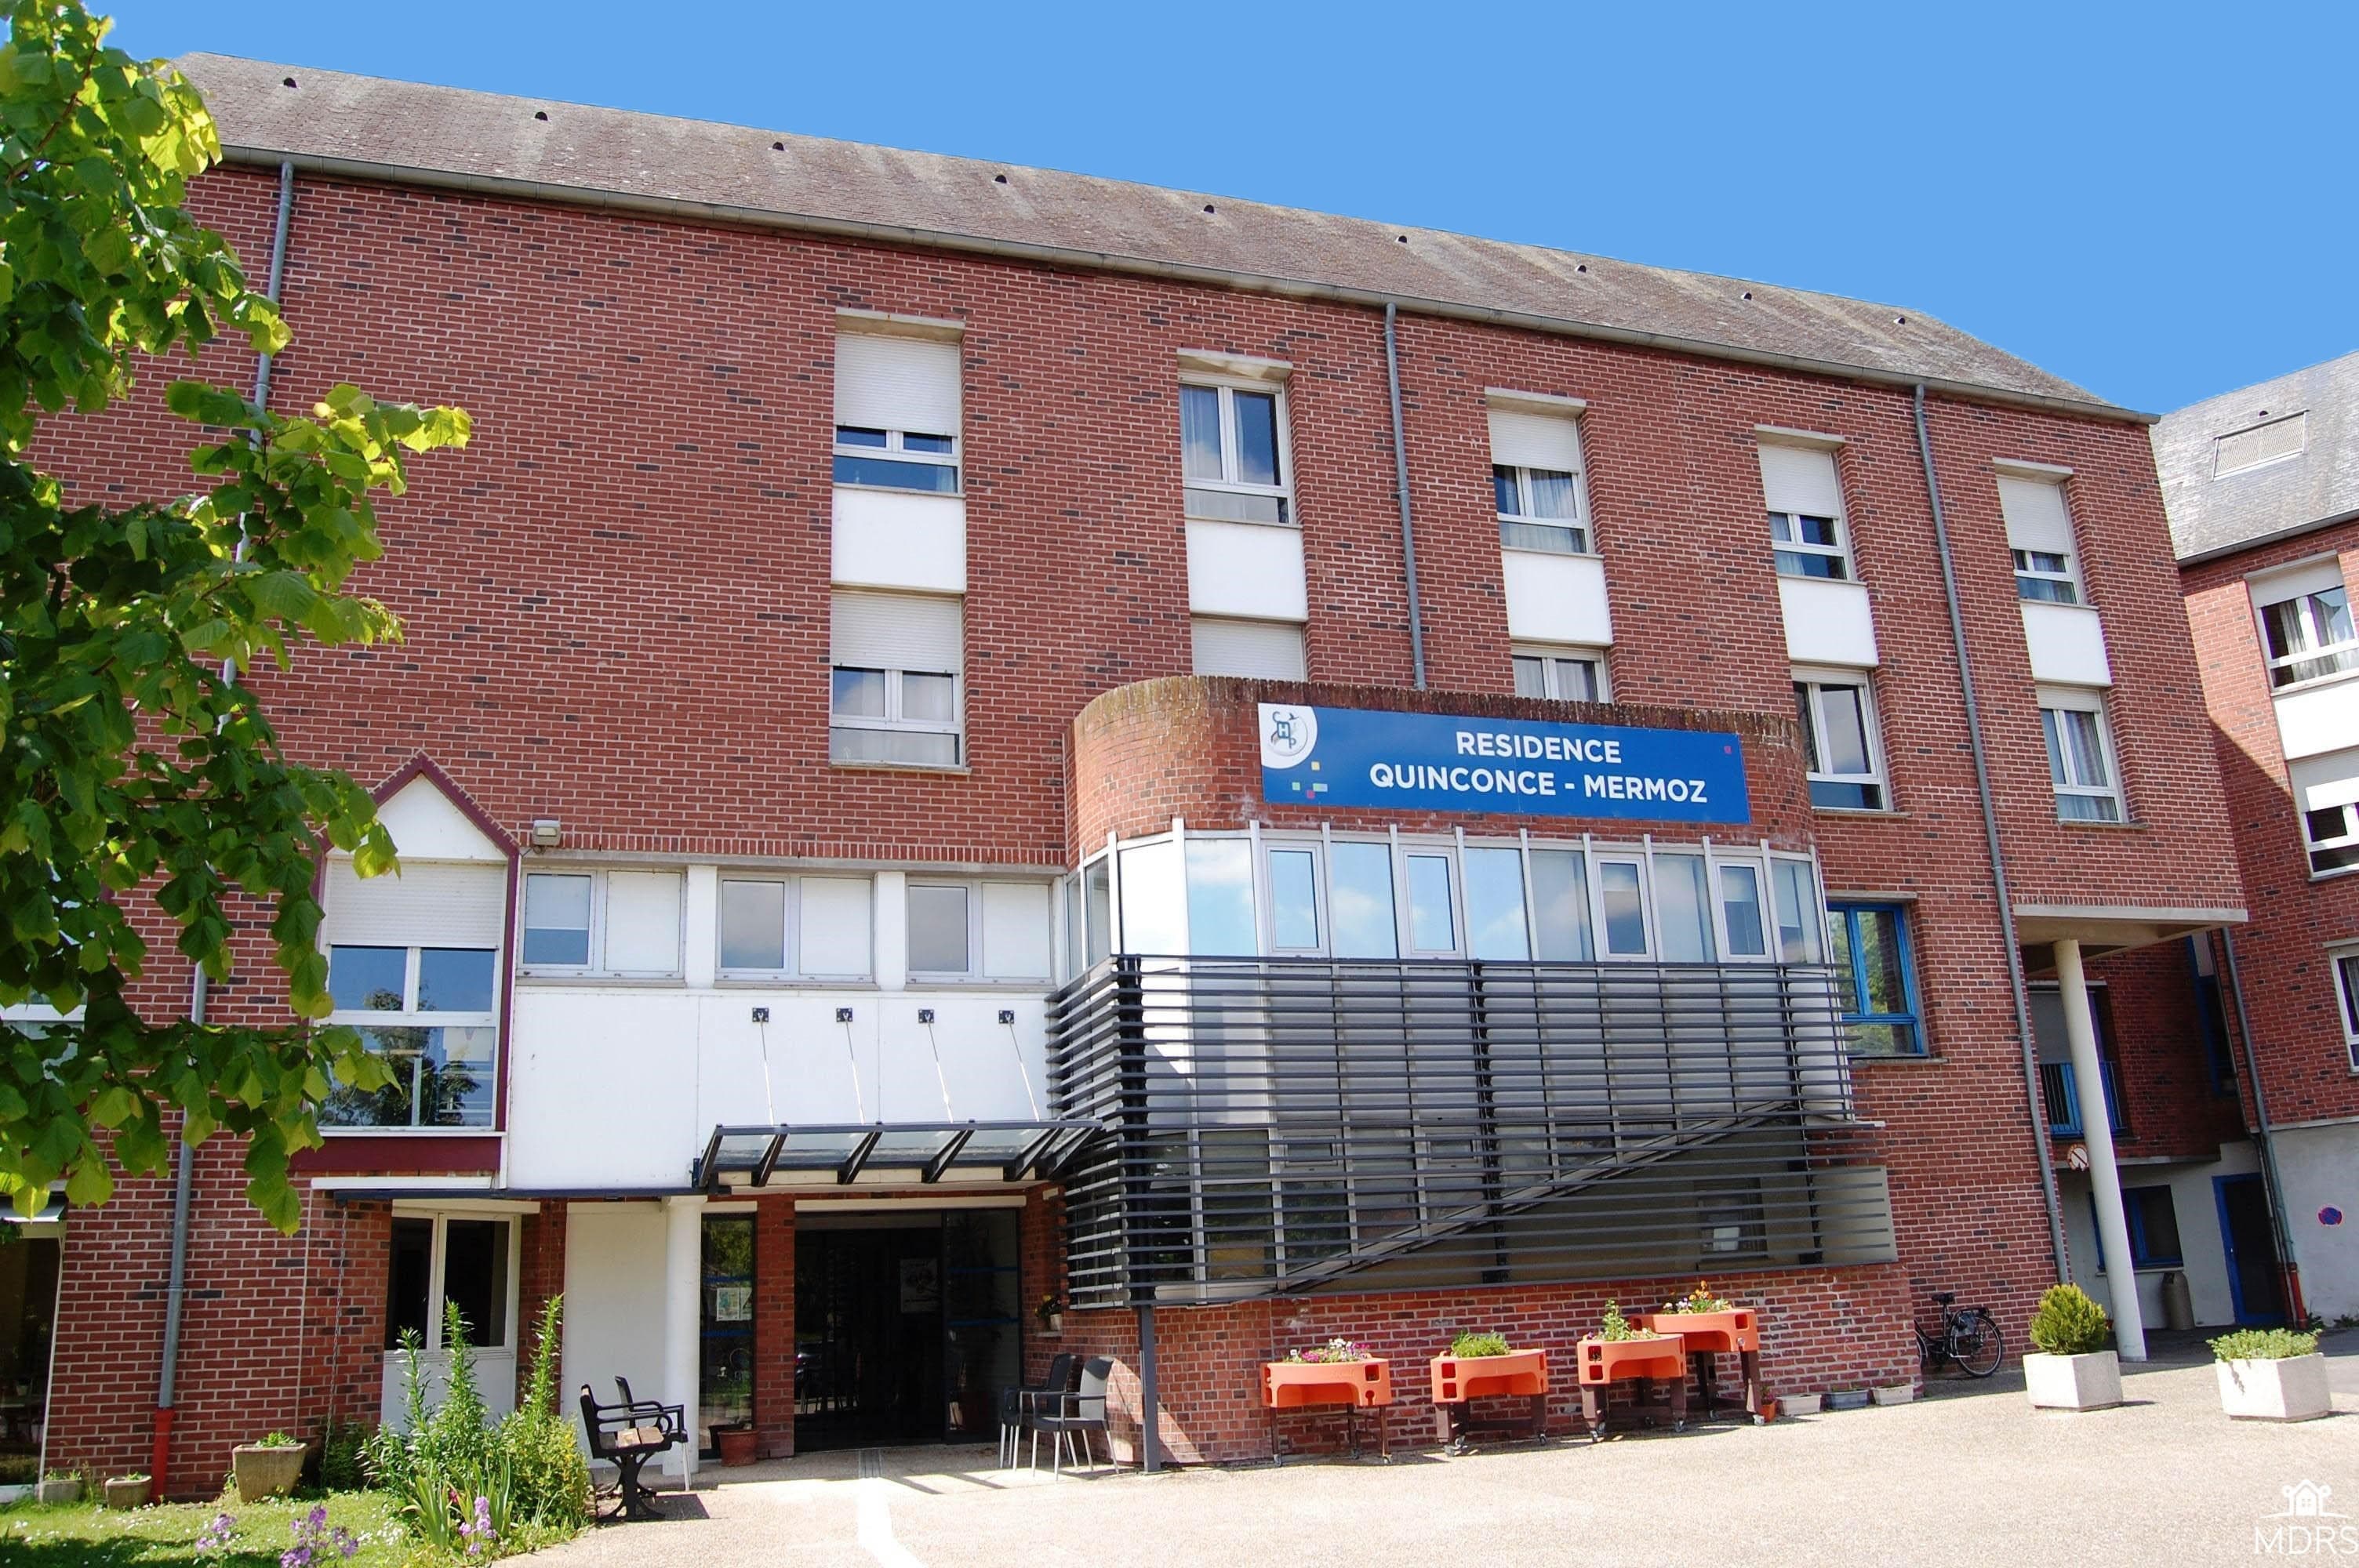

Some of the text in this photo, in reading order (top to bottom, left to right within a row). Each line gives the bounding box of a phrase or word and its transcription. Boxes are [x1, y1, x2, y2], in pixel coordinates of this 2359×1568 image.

[1456, 731, 1622, 764] RESIDENCE
[1369, 762, 1557, 796] QUINCONCE
[1583, 774, 1708, 804] MERMOZ
